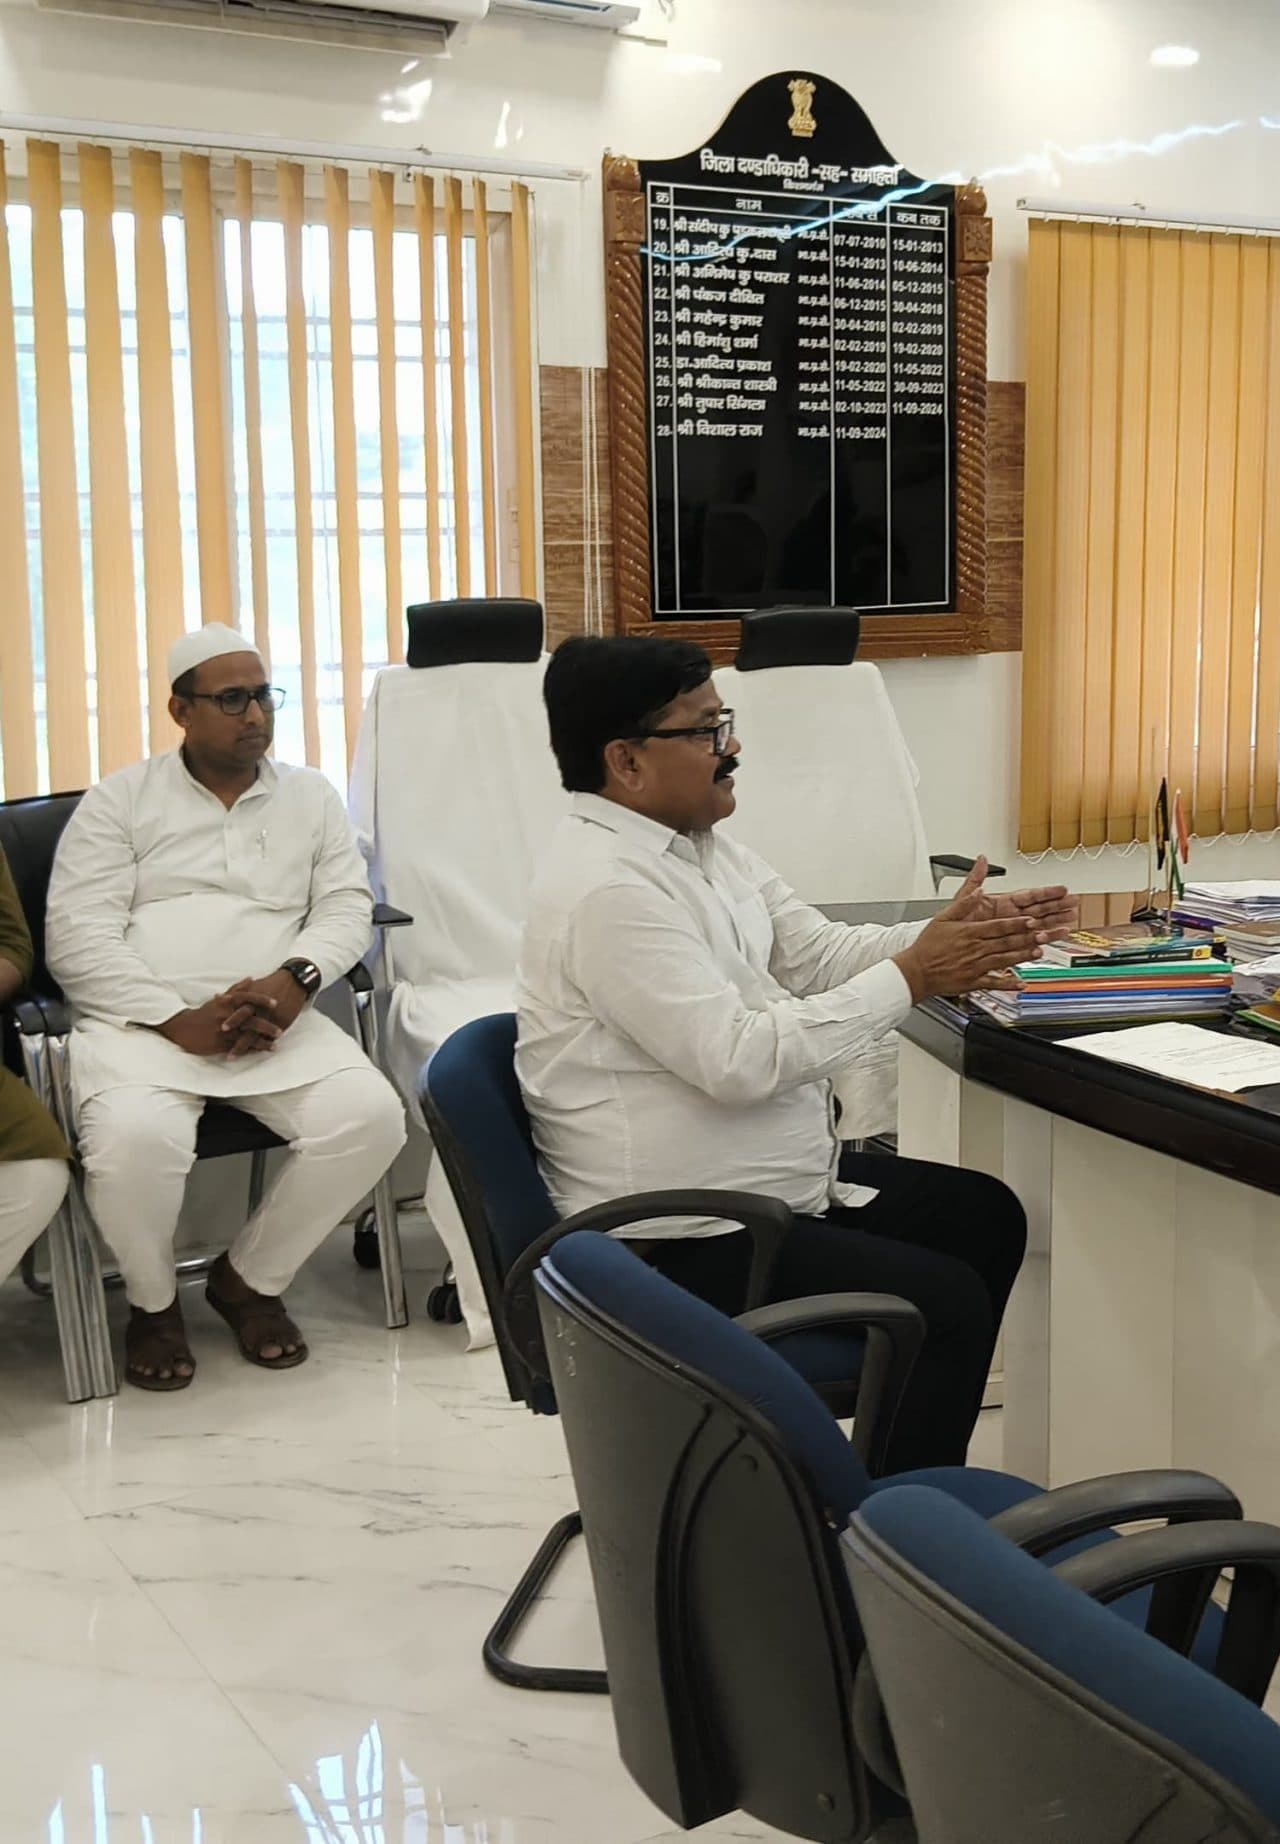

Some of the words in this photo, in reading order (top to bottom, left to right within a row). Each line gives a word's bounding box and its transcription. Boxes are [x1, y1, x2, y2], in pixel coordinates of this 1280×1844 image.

[700, 148, 735, 173] जिला
[737, 154, 809, 178] दण्डाधिकारी
[735, 198, 762, 211] नाम
[919, 213, 941, 226] तक
[673, 216, 687, 232] श्री
[688, 218, 717, 233] संदीप
[674, 238, 690, 255] श्री
[674, 262, 691, 278] श्री
[675, 284, 691, 300] श्री
[693, 286, 727, 302] पंकज
[675, 307, 692, 323] श्री
[729, 314, 764, 331] कुमार
[676, 330, 692, 346] श्री
[733, 334, 759, 349] शर्मा
[677, 372, 693, 389] श्री
[677, 392, 694, 409] श्री
[677, 419, 694, 437] श्री
[696, 419, 738, 438] विशाल
[739, 424, 763, 437] राज
